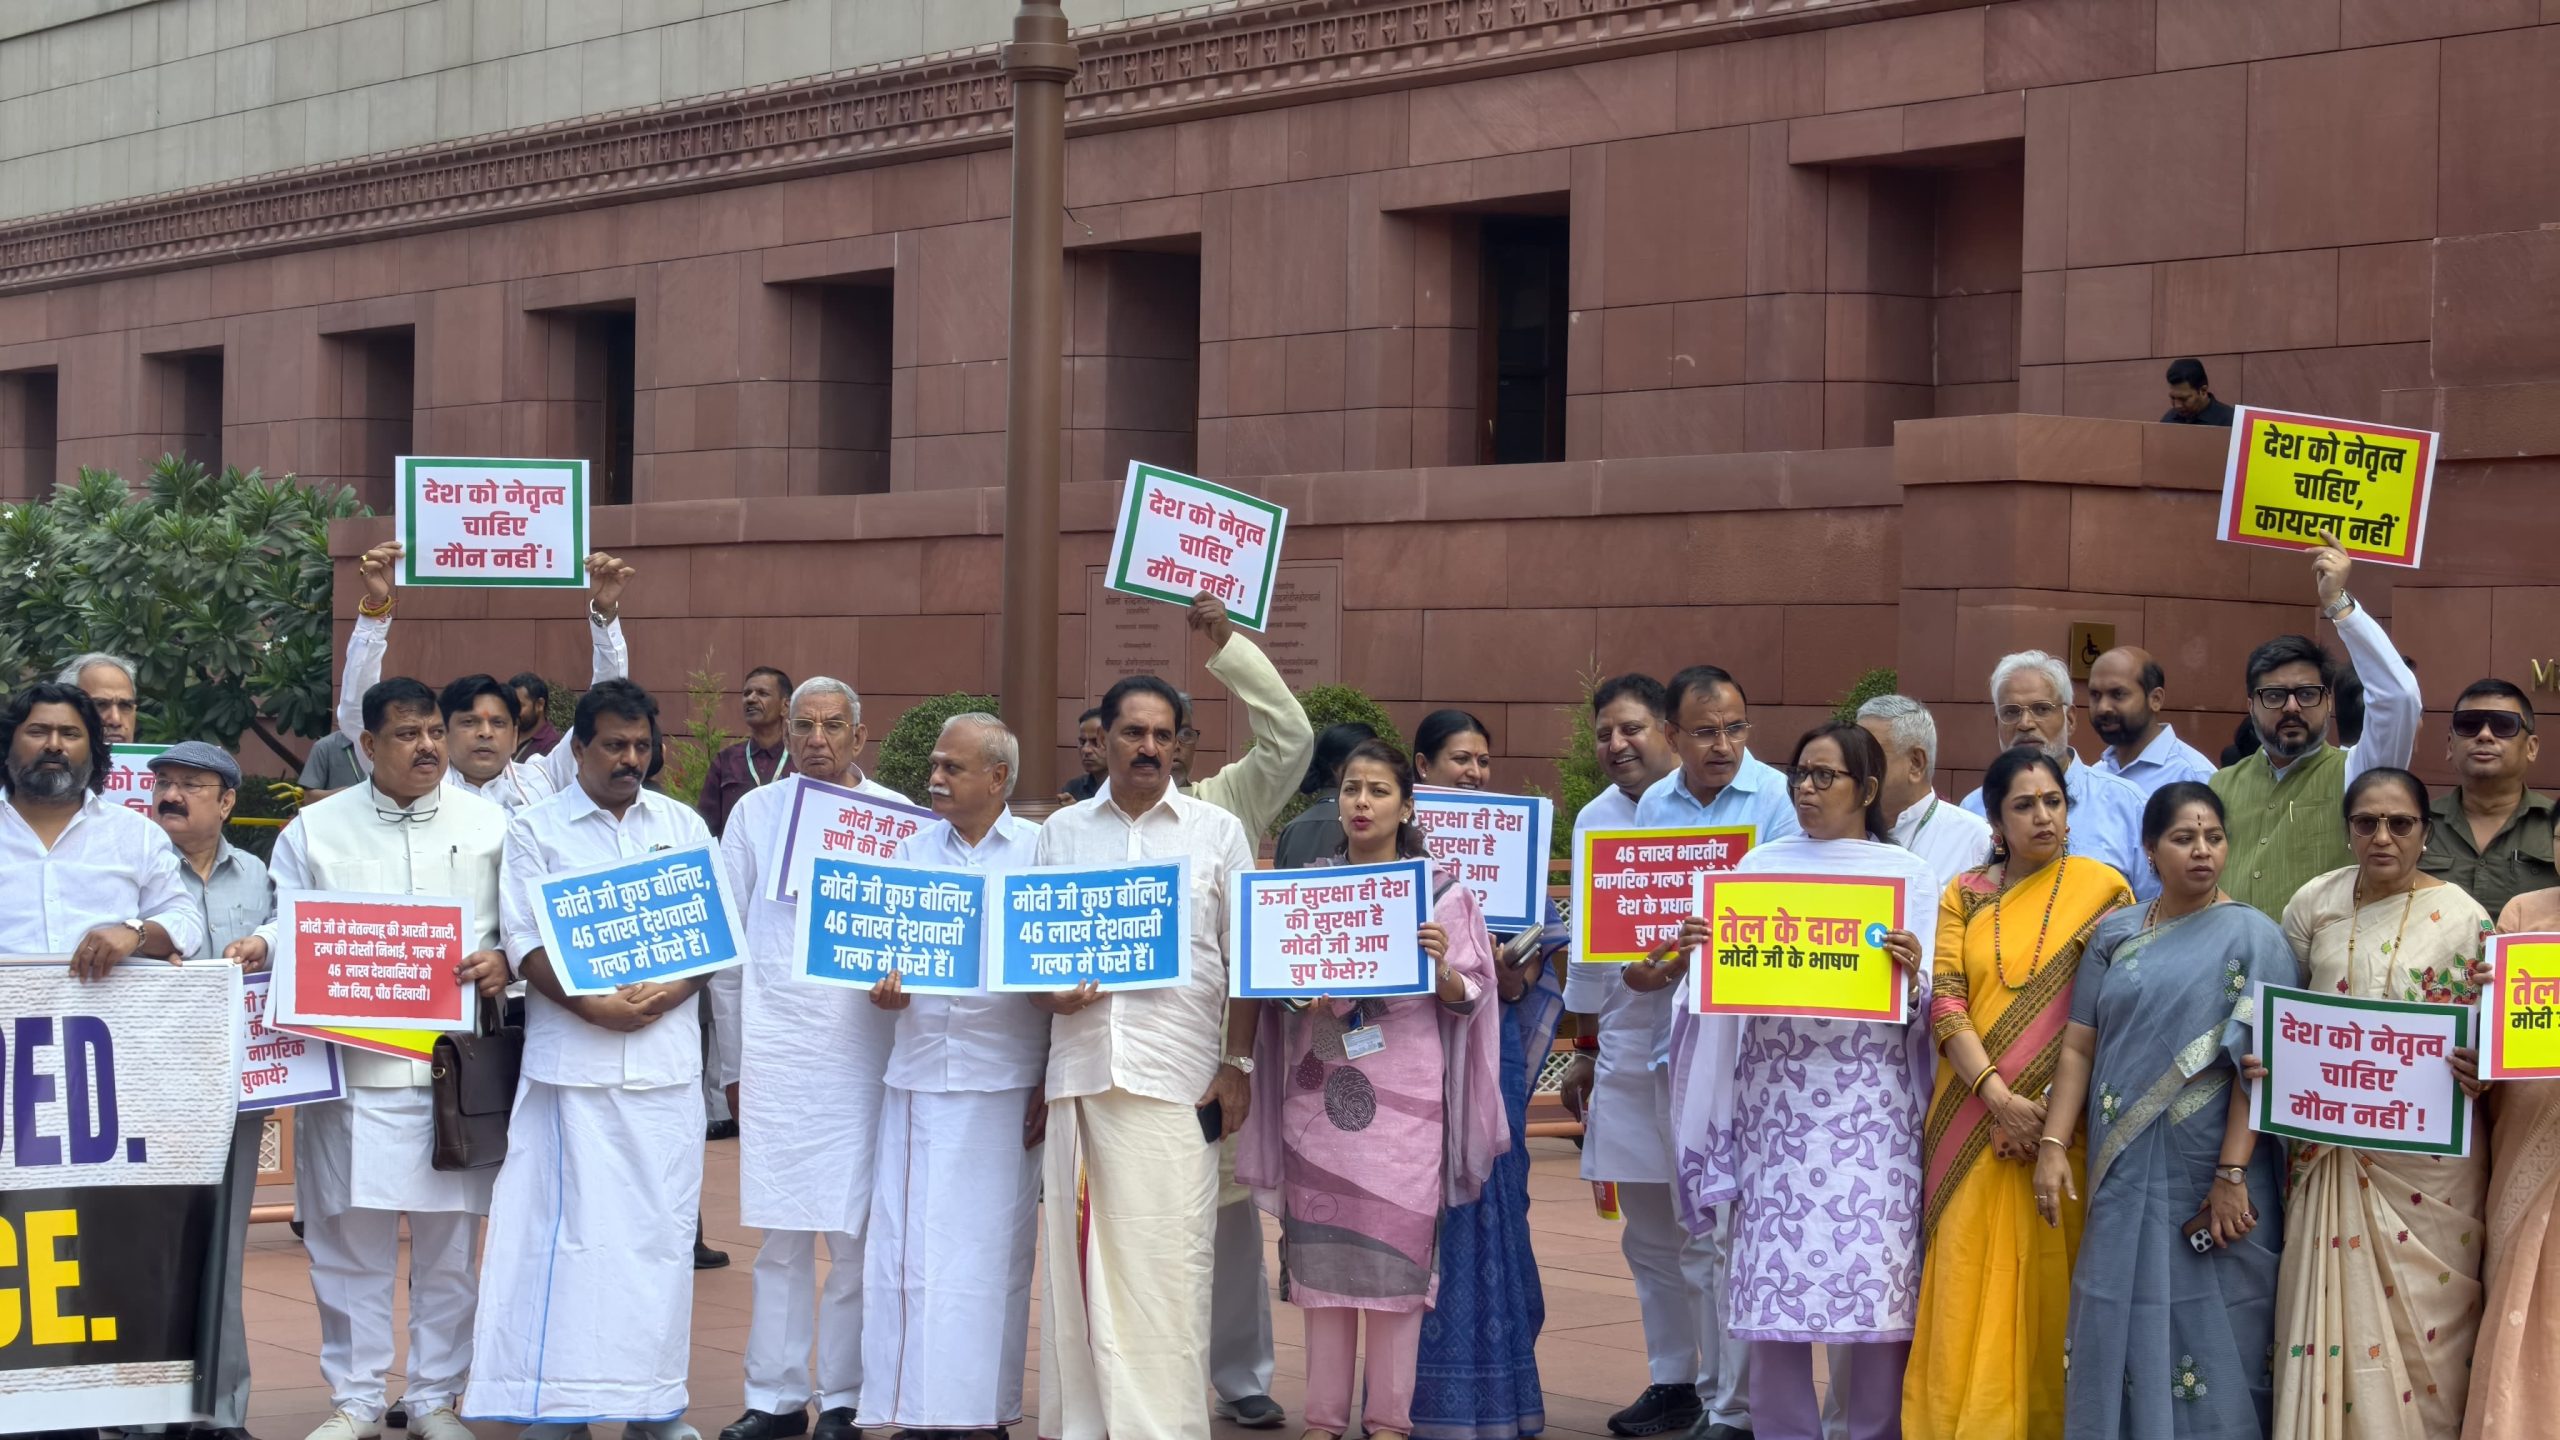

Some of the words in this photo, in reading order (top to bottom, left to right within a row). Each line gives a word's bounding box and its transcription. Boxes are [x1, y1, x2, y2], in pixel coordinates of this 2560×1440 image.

[2264, 424, 2303, 460] देश
[2307, 431, 2340, 464] को
[2343, 435, 2406, 482] नेतृत्व
[423, 478, 463, 503] देश
[466, 479, 499, 504] को
[503, 479, 566, 513] नेतृत्व
[2293, 469, 2363, 510] चाहिए,
[462, 511, 528, 536] चाहिए
[1149, 488, 1185, 520] देश
[1189, 502, 1216, 529] को
[1219, 509, 1266, 548] नेतृत्व
[2348, 513, 2400, 547] नहीं
[434, 542, 487, 568] मौन
[491, 543, 542, 568] नहीं
[1179, 533, 1233, 566] चाहिए
[1146, 556, 1197, 587] मौन
[1200, 570, 1239, 600] नहीं
[838, 806, 873, 831] मोदी
[875, 815, 895, 837] जी
[1471, 807, 1491, 830] ही
[1494, 808, 1524, 832] देश
[824, 828, 856, 851] चुप्पी
[857, 834, 878, 857] की
[1482, 833, 1497, 856] है
[1615, 846, 1634, 862] 46
[1638, 845, 1674, 862] लाख
[1677, 839, 1728, 861] भारतीय
[1466, 864, 1500, 882] आप
[1593, 868, 1649, 889] नागरिक
[1651, 871, 1685, 888] गल्फ
[552, 885, 594, 918] मोदी
[593, 880, 618, 911] जी
[617, 878, 651, 913] कुछ
[650, 863, 711, 897] बोलिए,
[820, 870, 858, 901] मोदी
[860, 875, 883, 905] जी
[884, 883, 916, 914] कुछ
[919, 881, 976, 917] बोलिए,
[1012, 883, 1052, 912] मोदी
[1055, 881, 1079, 911] जी
[1080, 886, 1113, 916] कुछ
[1115, 876, 1172, 907] बोलिए,
[1257, 883, 1298, 906] ऊर्जा
[1300, 885, 1355, 909] सुरक्षा
[1357, 878, 1378, 900] ही
[1380, 876, 1410, 898] देश
[1617, 895, 1640, 915] देश
[1643, 894, 1658, 914] के
[299, 917, 322, 934] मोदी
[323, 918, 336, 935] जी
[387, 921, 399, 937] की
[401, 922, 428, 938] आरती
[571, 924, 595, 950] 46
[594, 914, 640, 945] लाख
[639, 893, 708, 936] देशवासी
[824, 909, 847, 934] 46
[851, 913, 894, 940] लाख
[896, 912, 965, 946] देशवासी
[1020, 921, 1043, 944] 46
[1047, 919, 1093, 943] लाख
[1094, 908, 1163, 945] देशवासी
[1284, 908, 1310, 930] की
[1312, 910, 1367, 935] सुरक्षा
[1369, 904, 1384, 926] है
[1718, 906, 1768, 944] तेल
[1772, 907, 1801, 944] के
[1805, 916, 1861, 947] दाम
[335, 942, 347, 956] की
[437, 944, 447, 959] में
[1280, 932, 1323, 955] मोदी
[1326, 932, 1350, 954] जी
[1354, 934, 1389, 953] आप
[1635, 925, 1655, 947] चुप
[328, 964, 341, 977] 46
[346, 965, 369, 979] लाख
[419, 964, 432, 980] को
[588, 954, 631, 979] गल्फ
[629, 939, 651, 970] में
[833, 945, 874, 971] गल्फ
[876, 944, 896, 973] में
[1030, 952, 1073, 975] गल्फ
[1075, 945, 1096, 974] में
[1719, 944, 1758, 968] मोदी
[1761, 945, 1786, 968] जी
[1787, 945, 1805, 968] के
[1809, 951, 1860, 971] भाषण
[1290, 963, 1317, 986] चुप
[2511, 968, 2560, 1005] तेल
[328, 984, 349, 998] मौन
[2510, 1006, 2553, 1029] मोदी
[246, 1037, 305, 1061] नागरिक
[2280, 1011, 2322, 1046] देश
[2327, 1021, 2364, 1051] को
[2369, 1024, 2446, 1066] नेतृत्व
[2320, 1060, 2397, 1092] चाहिए
[2289, 1090, 2347, 1124] मौन
[2351, 1100, 2414, 1130] नहीं
